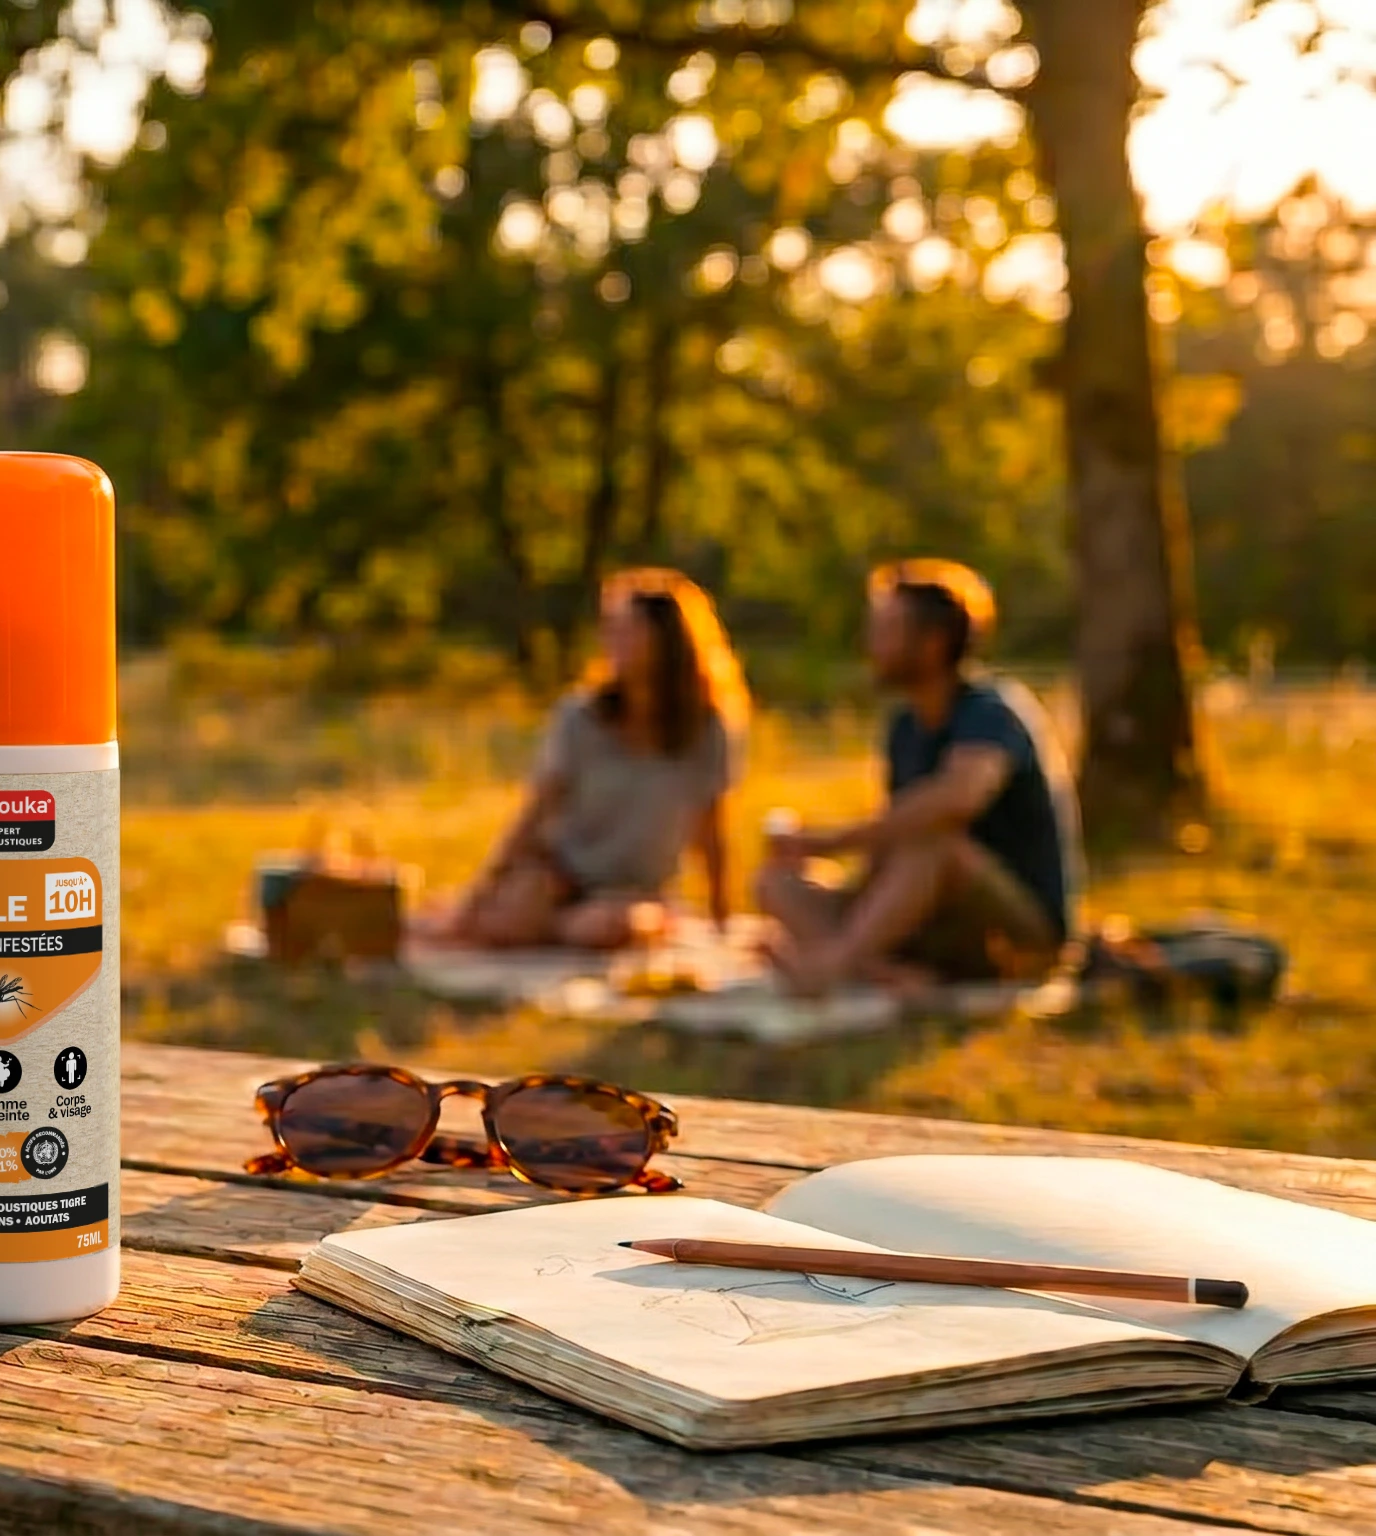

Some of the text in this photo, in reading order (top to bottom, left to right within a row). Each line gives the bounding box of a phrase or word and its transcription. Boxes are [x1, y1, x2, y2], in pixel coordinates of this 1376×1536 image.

[49, 889, 92, 914] 10H
[56, 1094, 86, 1109] Corps
[48, 1105, 92, 1119] & visage
[60, 1196, 87, 1209] TIGRE
[25, 1212, 70, 1226] AOUTATS
[77, 1231, 103, 1249] 75ML
